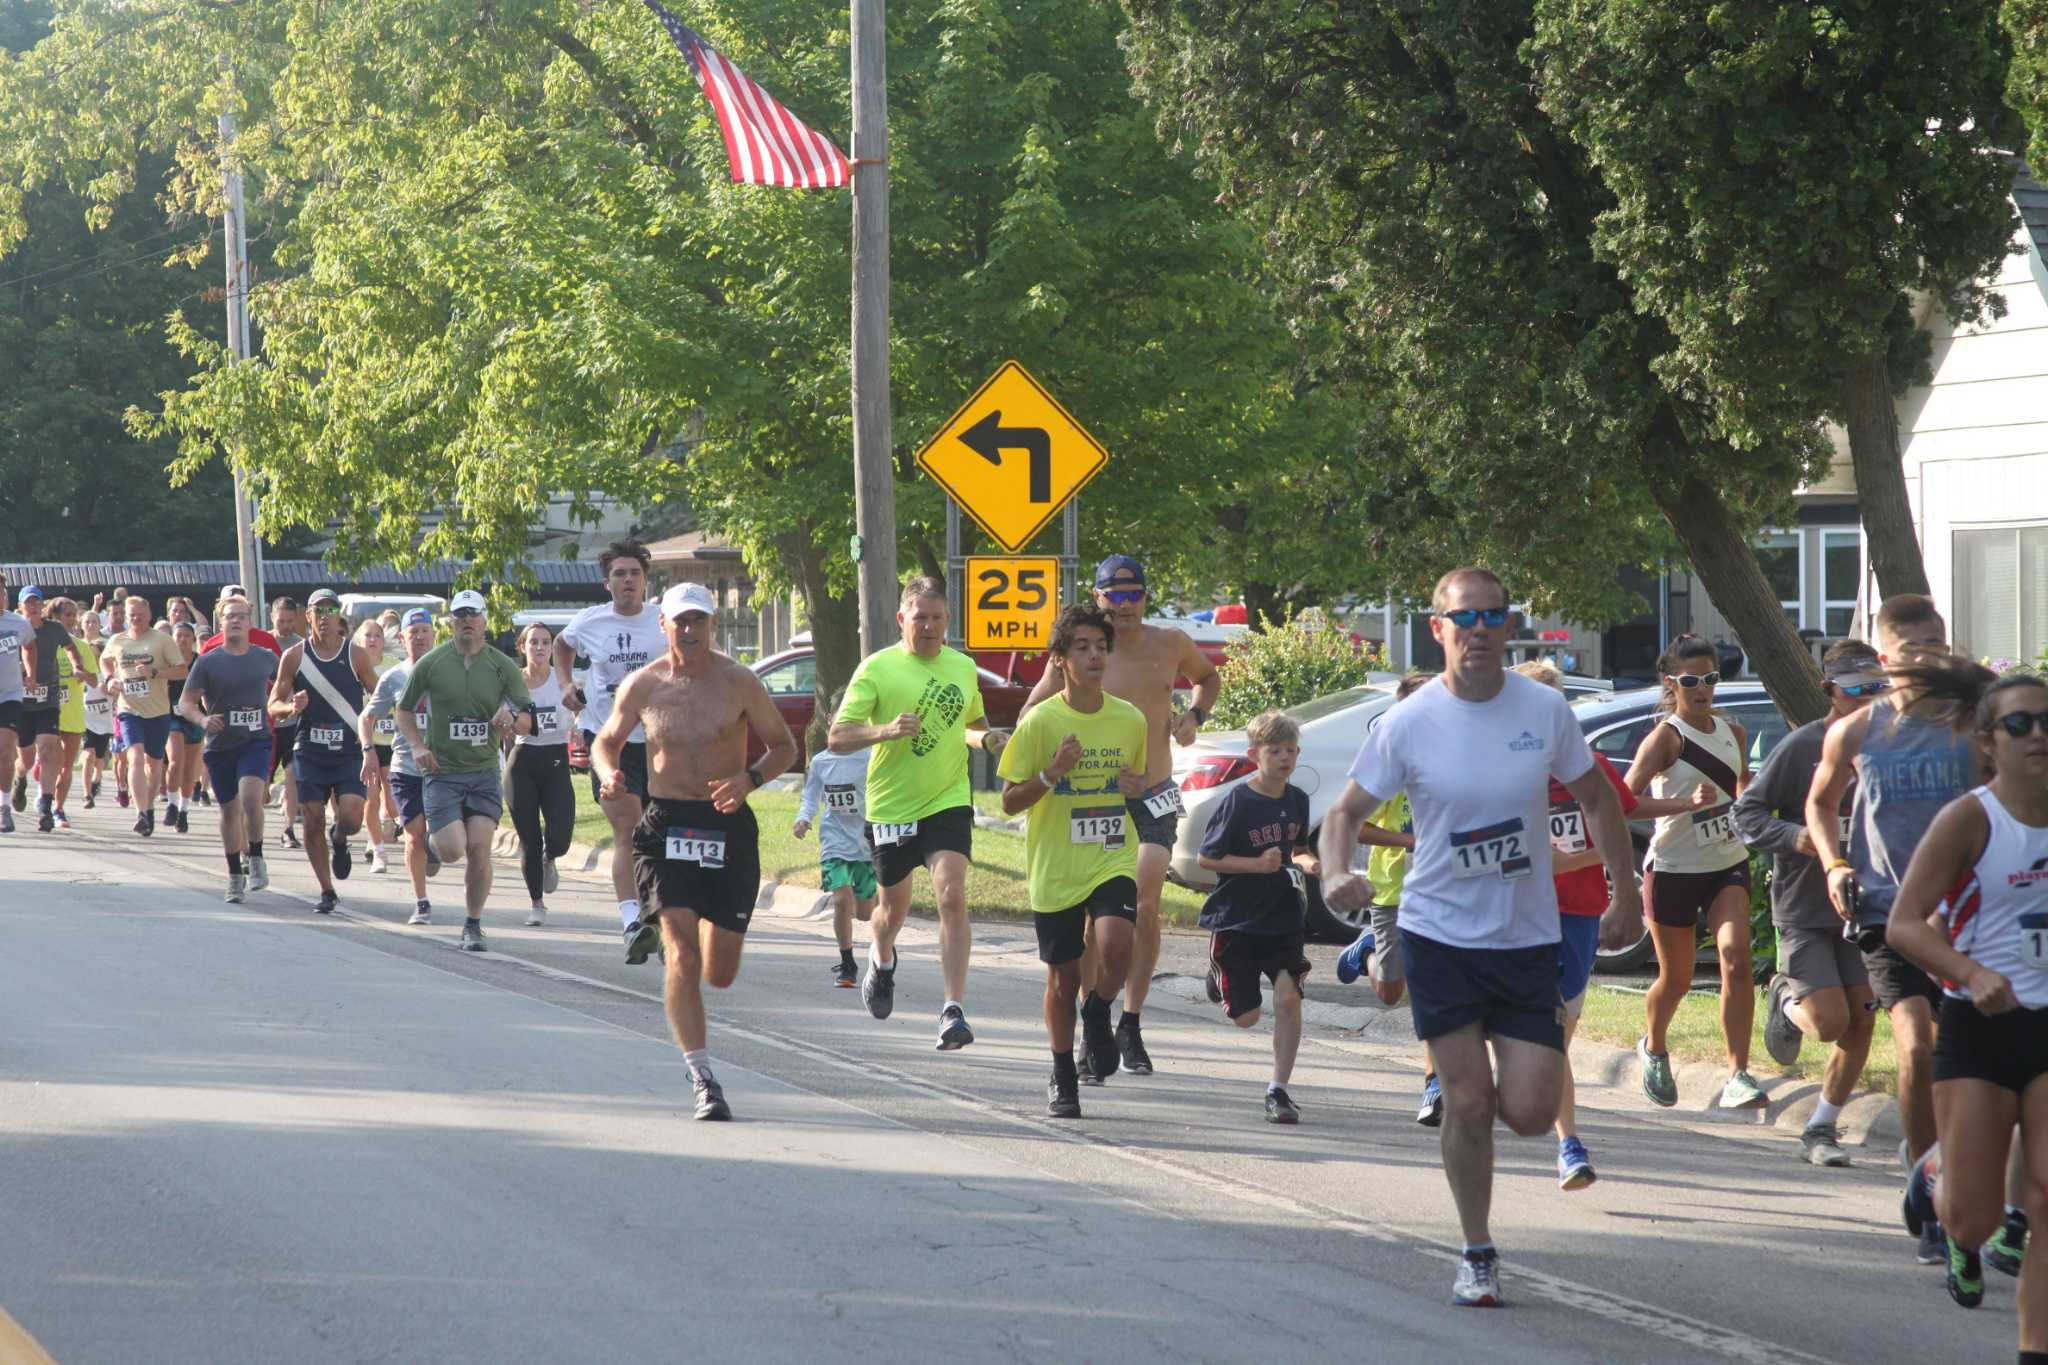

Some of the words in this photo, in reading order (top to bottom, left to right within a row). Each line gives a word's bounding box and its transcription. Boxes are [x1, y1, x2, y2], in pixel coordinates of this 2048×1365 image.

[978, 569, 1047, 610] 25
[987, 621, 1037, 638] MPH
[233, 712, 259, 723] 1461
[313, 729, 341, 740] 1132
[453, 724, 486, 737] 1439
[876, 822, 913, 839] 1112
[1076, 818, 1122, 837] 1139
[672, 839, 719, 857] 1113
[1458, 836, 1522, 868] 1172
